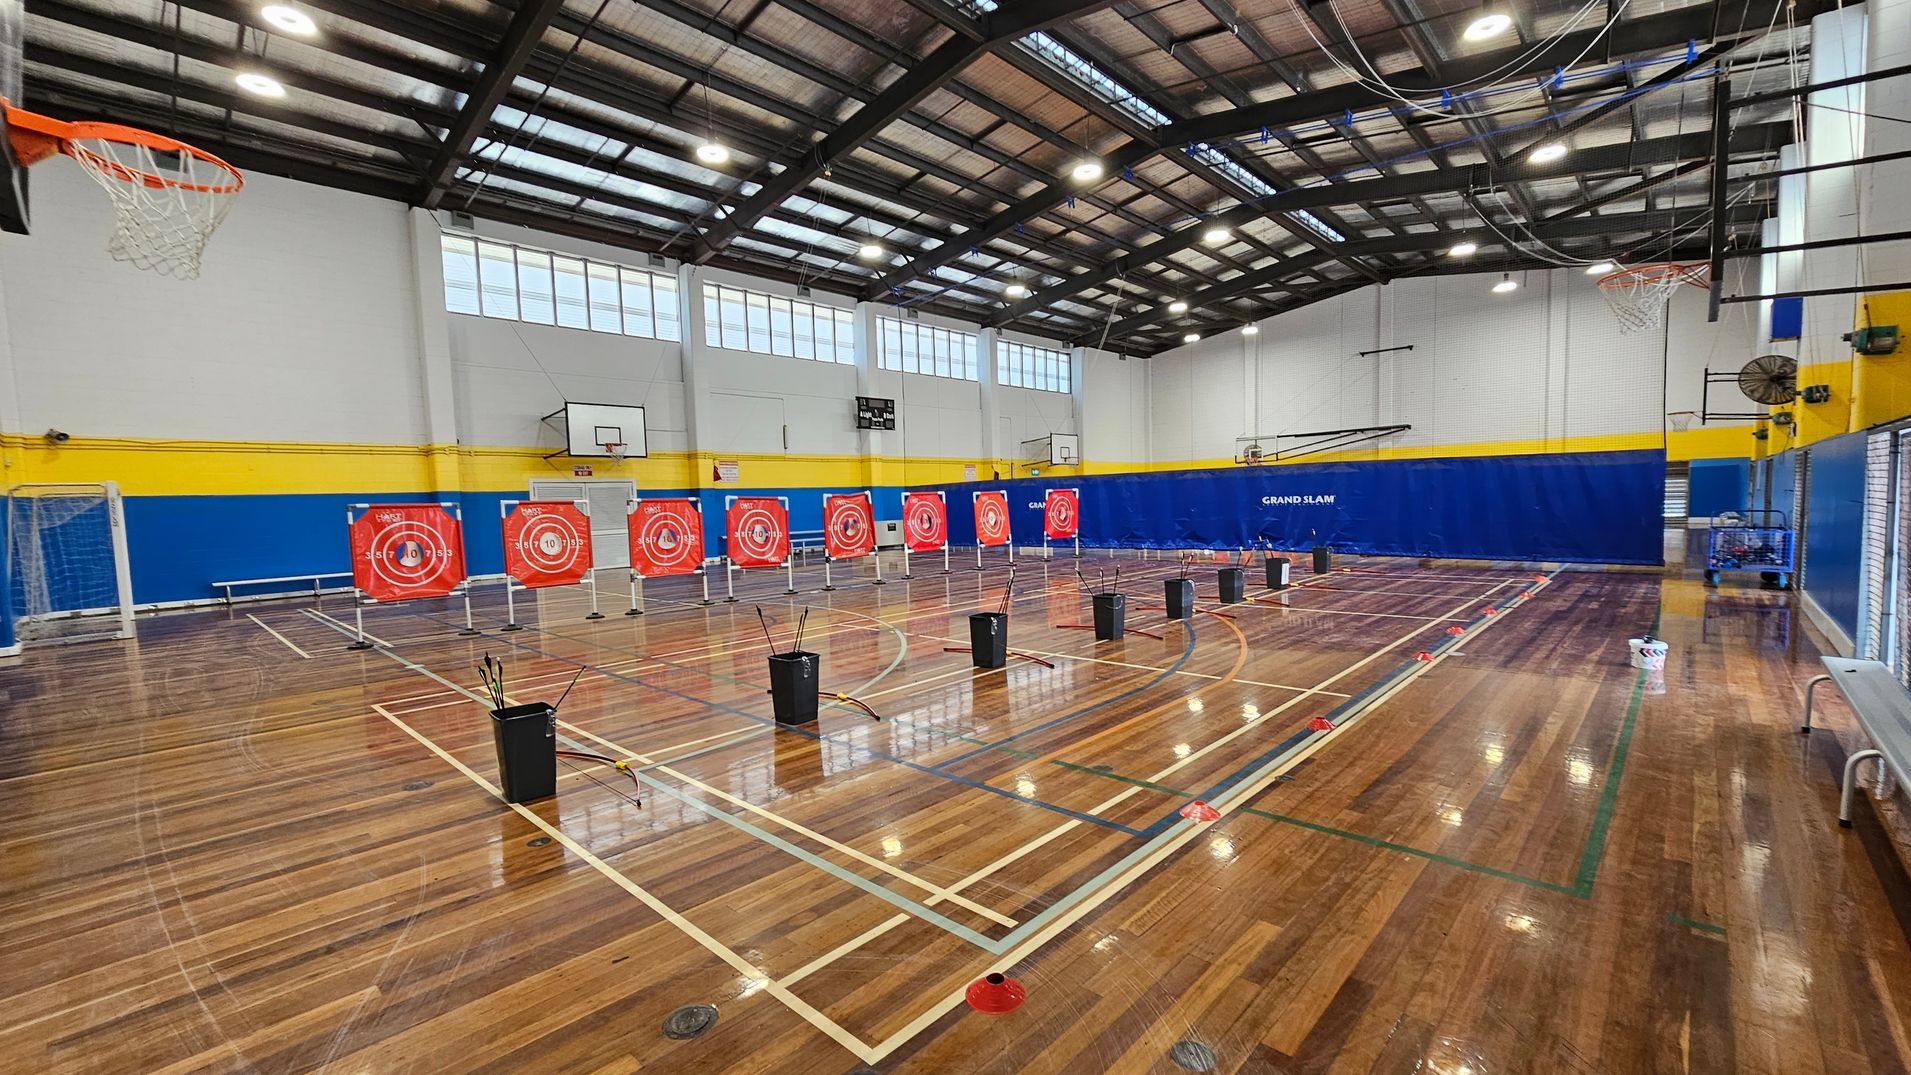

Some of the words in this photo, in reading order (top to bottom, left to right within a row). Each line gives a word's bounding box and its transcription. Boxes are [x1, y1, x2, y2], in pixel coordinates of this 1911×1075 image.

[1262, 496, 1301, 504] GRAND
[1303, 495, 1335, 503] SLAM
[545, 540, 555, 548] 10
[365, 552, 371, 560] 3
[375, 551, 382, 559] 5
[388, 551, 395, 559] 7
[425, 549, 432, 557] 7
[436, 549, 443, 557] 5
[447, 549, 453, 557] 3
